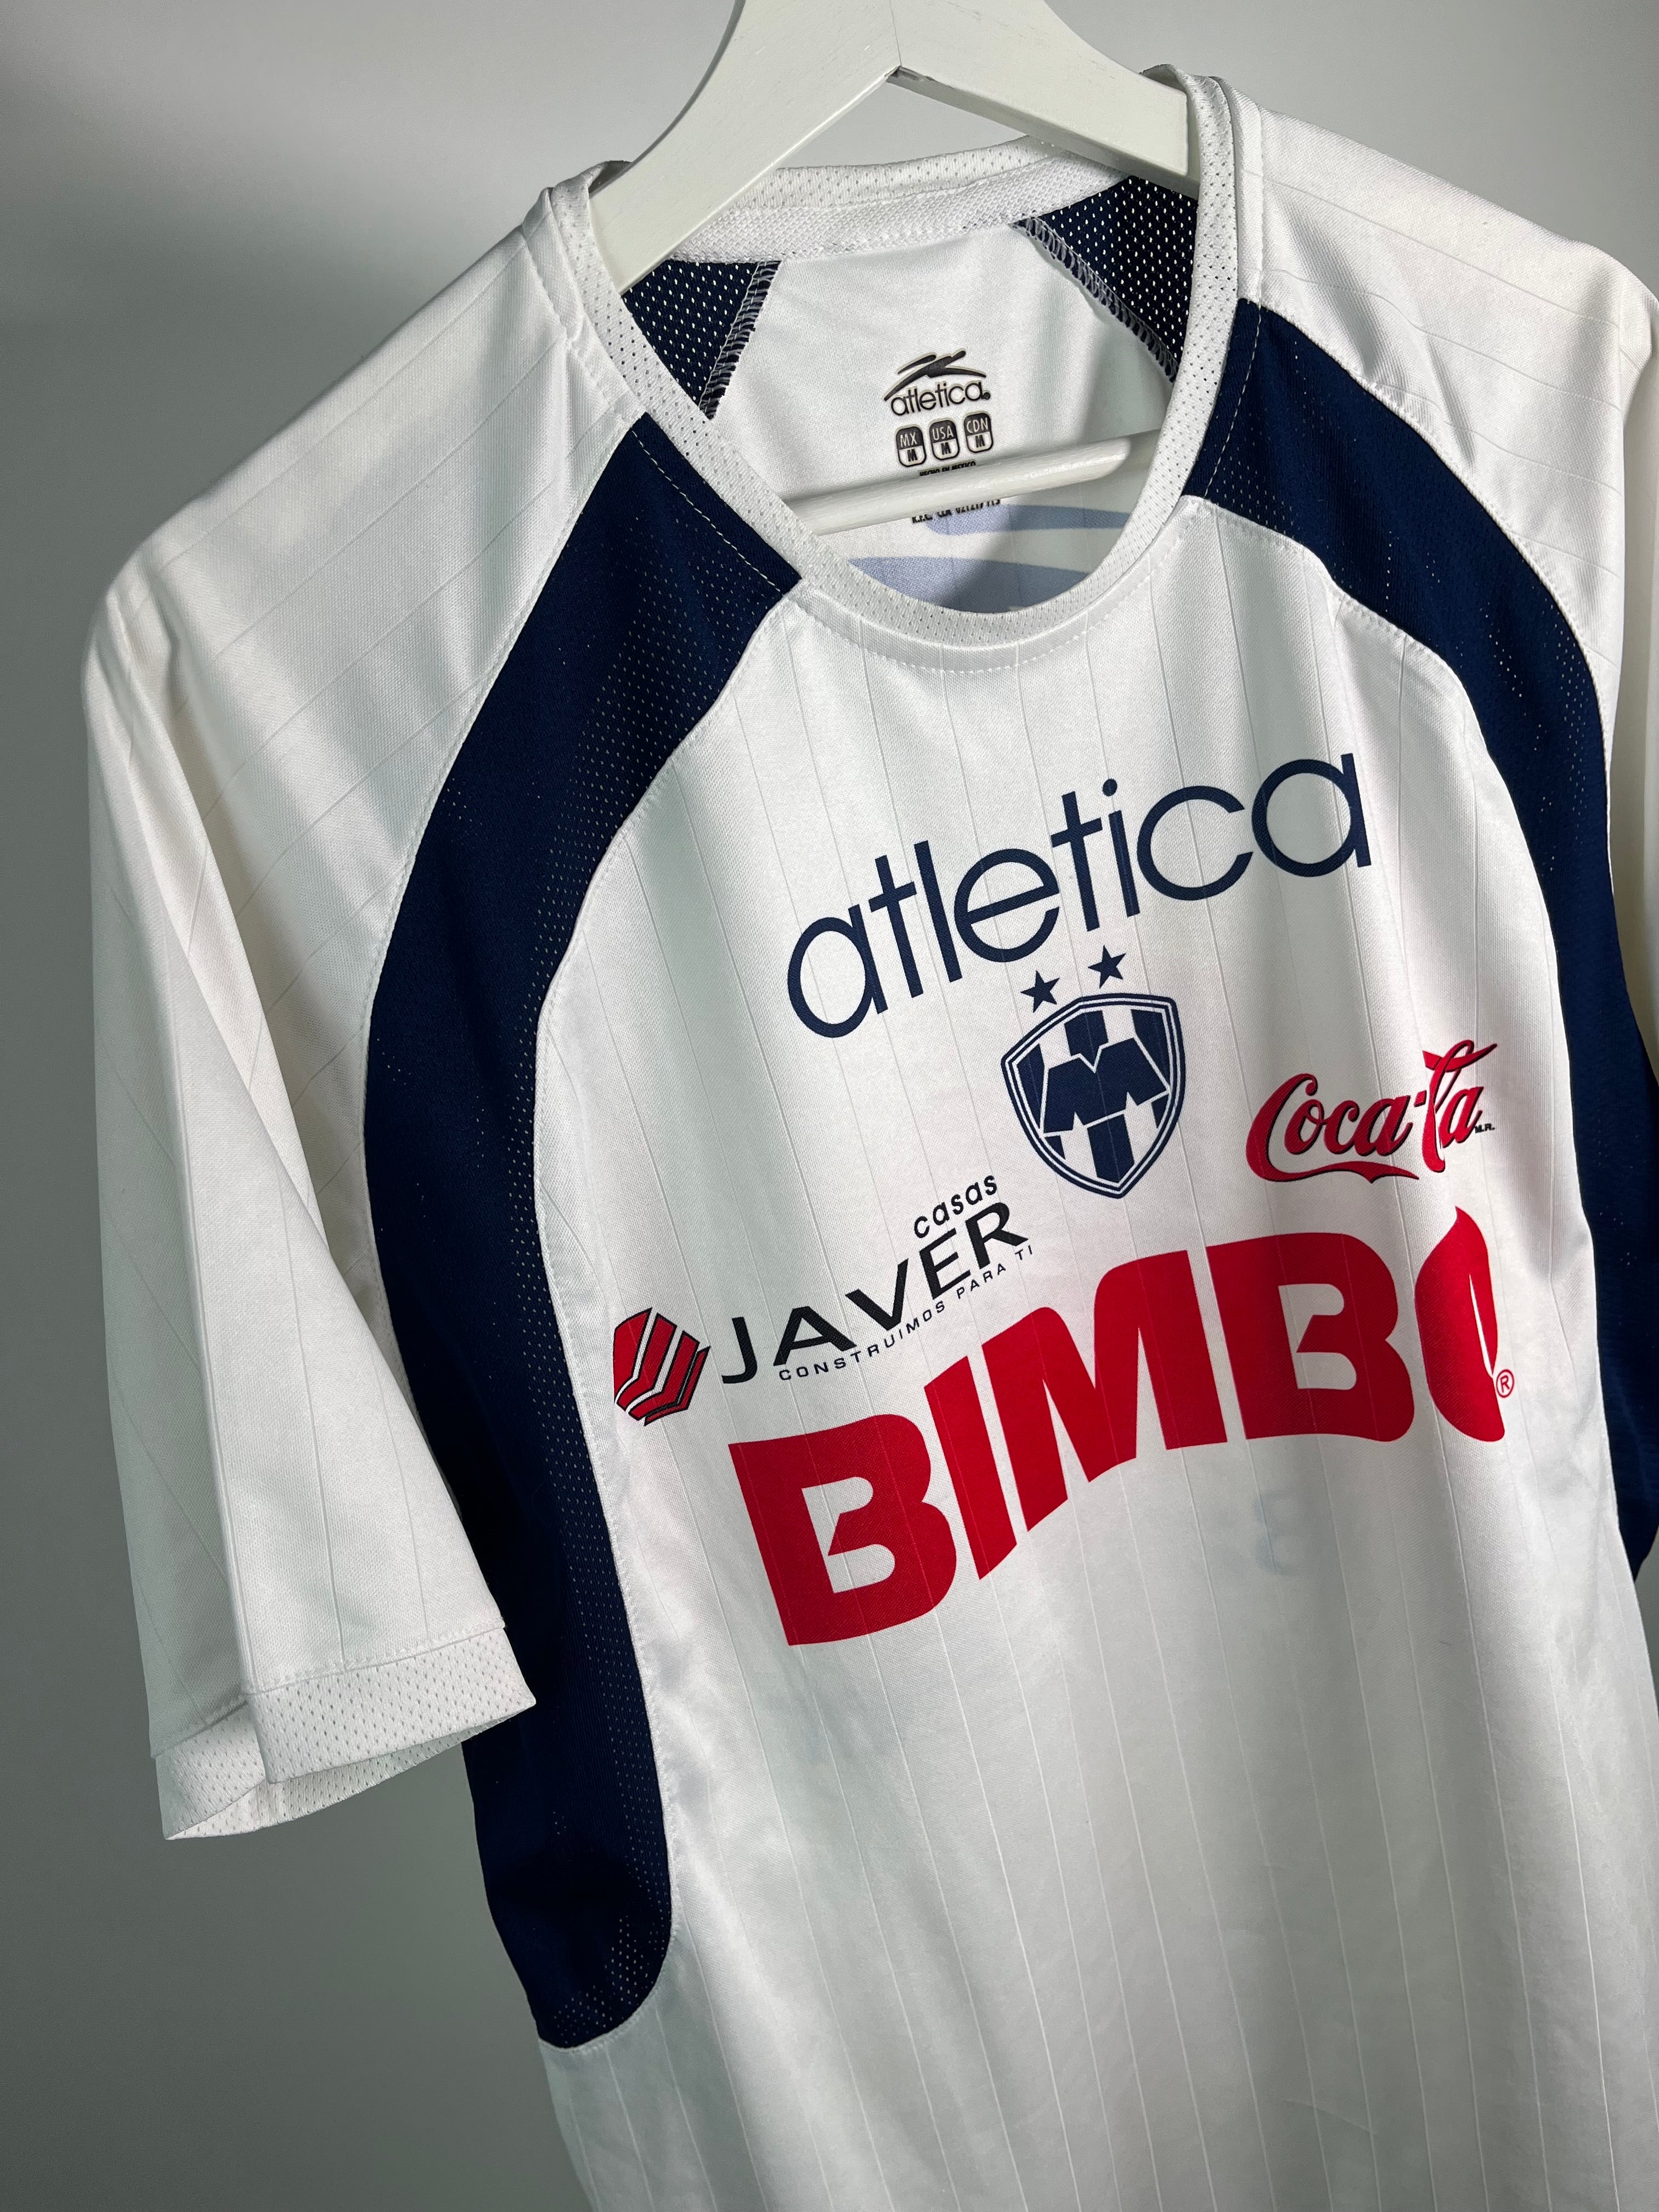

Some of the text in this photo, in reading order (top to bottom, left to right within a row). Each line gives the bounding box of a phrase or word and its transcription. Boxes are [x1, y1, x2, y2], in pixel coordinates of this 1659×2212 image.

[891, 381, 985, 416] atletica
[900, 417, 989, 448] MX USA CDN
[907, 434, 985, 462] M M M
[787, 753, 1372, 1039] atletica
[914, 1175, 997, 1239] casas
[721, 1202, 1029, 1384] JAVER
[778, 1245, 1033, 1381] CONSTRUIMOS PARA TI
